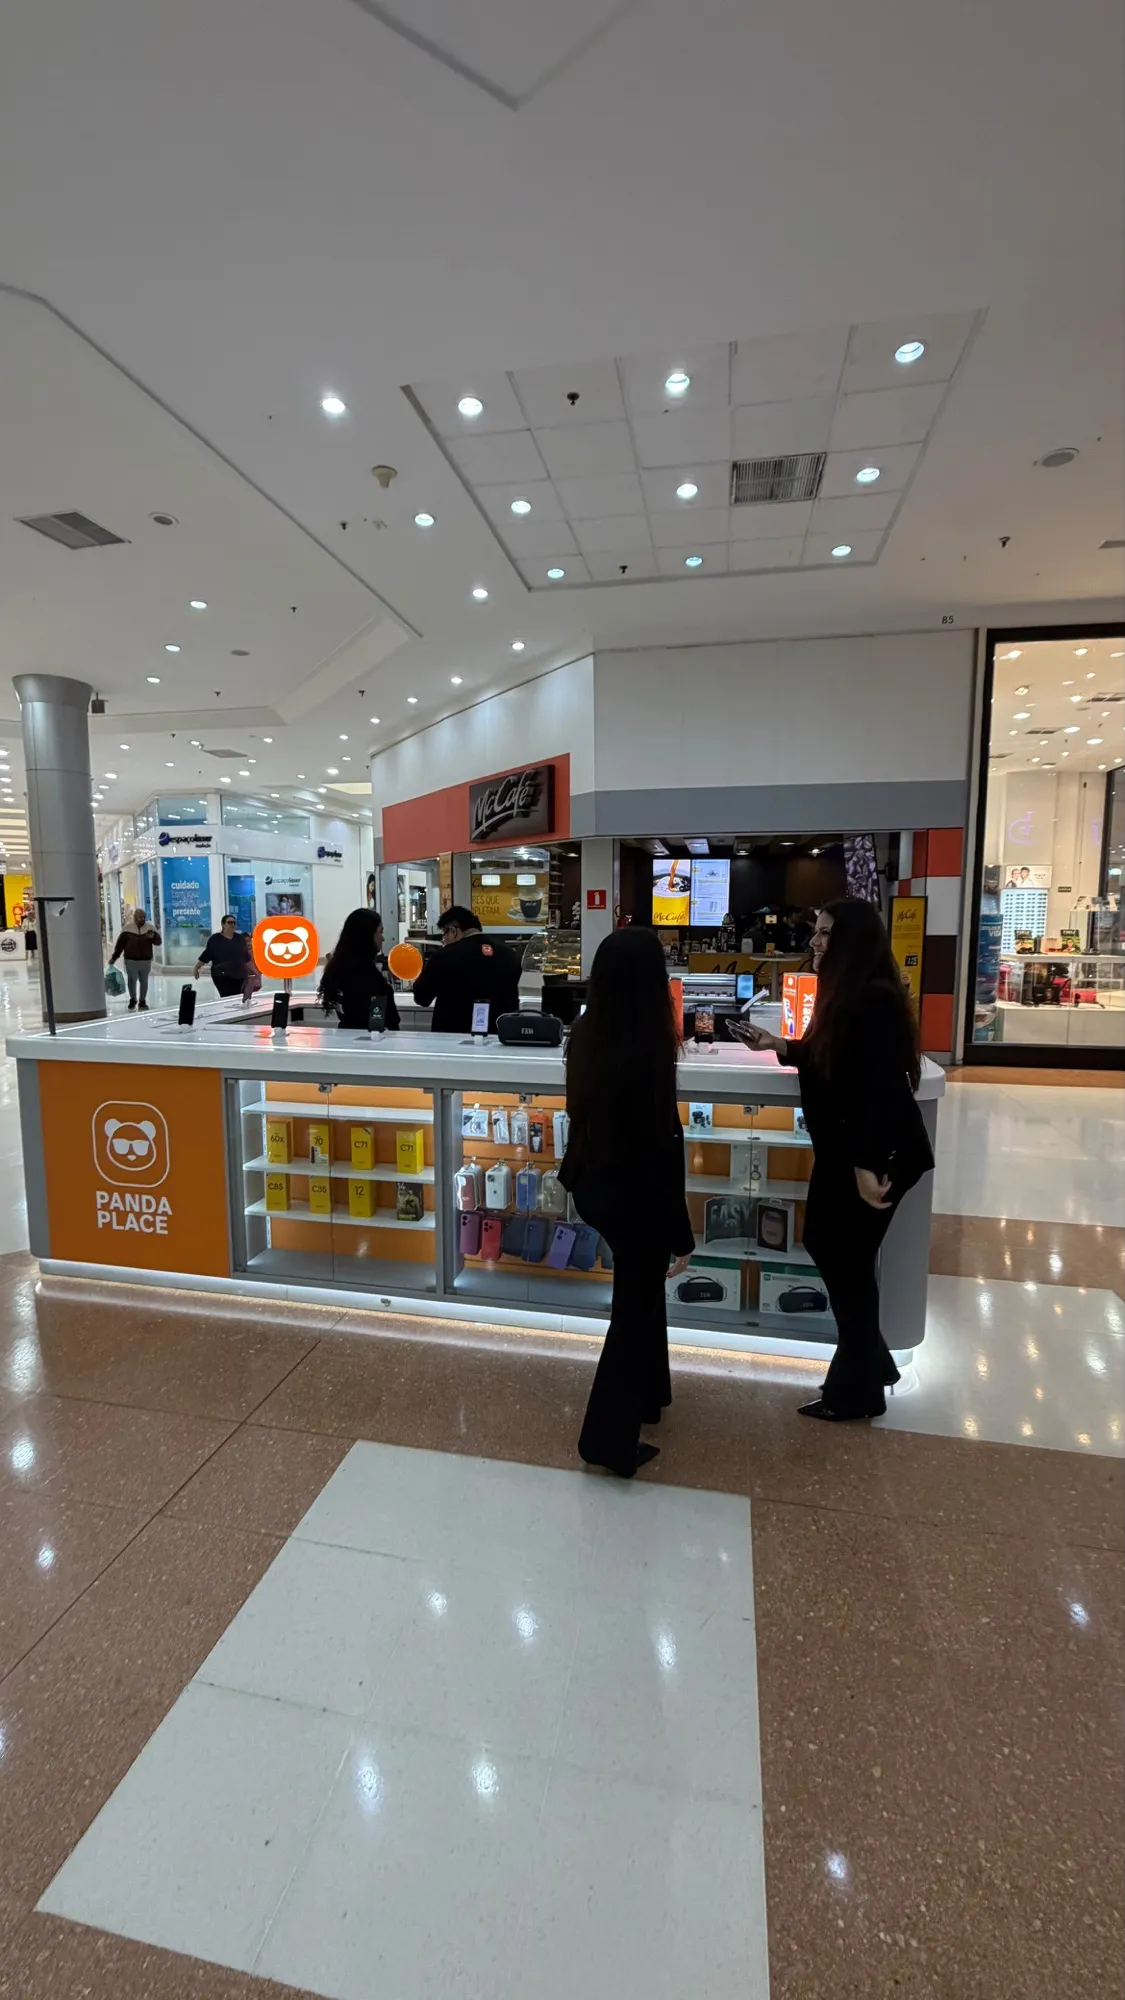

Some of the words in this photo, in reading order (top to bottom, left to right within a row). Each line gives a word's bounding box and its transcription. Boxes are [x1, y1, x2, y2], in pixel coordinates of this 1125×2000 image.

[942, 615, 954, 625] 85
[473, 769, 537, 832] McCafé
[171, 880, 200, 890] cuidado
[486, 896, 499, 905] QUE
[173, 908, 201, 918] presente
[354, 1140, 368, 1149] C71
[400, 1144, 414, 1153] C71
[354, 1185, 365, 1196] 12
[95, 1190, 173, 1216] PANDA
[97, 1210, 168, 1235] PLACE
